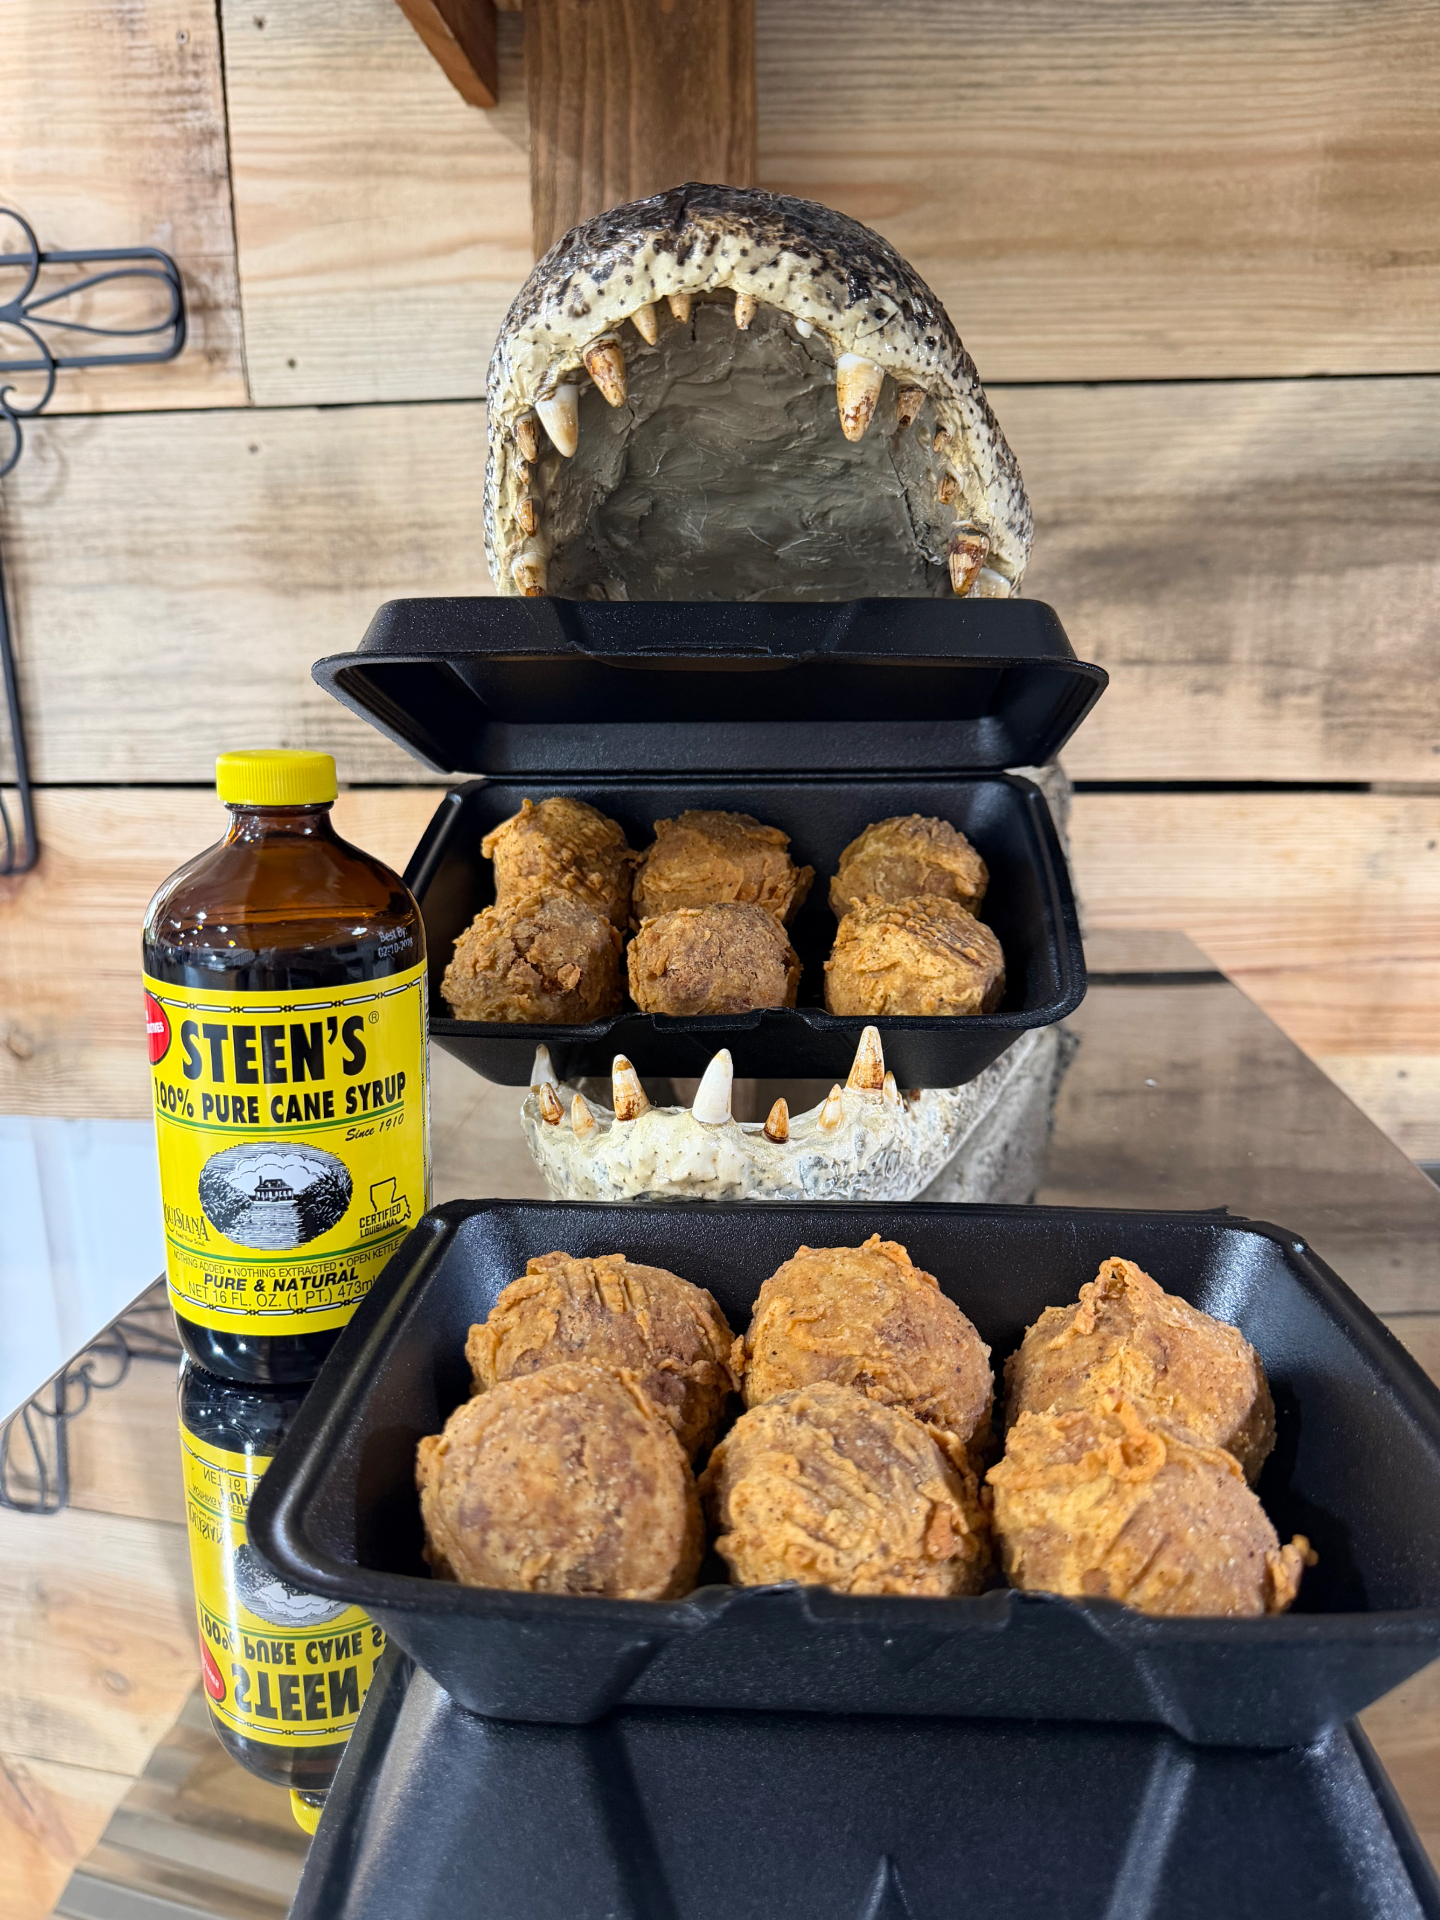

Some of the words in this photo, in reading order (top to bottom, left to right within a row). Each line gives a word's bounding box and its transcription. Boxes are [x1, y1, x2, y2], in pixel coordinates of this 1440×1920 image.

[379, 928, 396, 943] Best
[181, 1015, 367, 1085] STEEN'S
[154, 1076, 194, 1118] 100%
[202, 1092, 260, 1124] PURE
[271, 1090, 335, 1124] CANE
[345, 1071, 406, 1115] SYRUP
[345, 1127, 375, 1142] Since
[379, 1113, 404, 1132] 1910
[359, 1203, 401, 1228] CERTIFIED
[360, 1218, 397, 1239] LOUISIANA
[173, 1249, 198, 1269] NOTHING
[199, 1260, 225, 1275] ADDED
[233, 1267, 276, 1278] NOTHING
[278, 1262, 337, 1278] EXTRACTED
[346, 1252, 371, 1268] OPEN
[373, 1240, 400, 1260] KETTLE
[204, 1272, 248, 1292] PURE
[253, 1279, 266, 1292] &
[273, 1267, 359, 1293] NATURAL
[188, 1281, 209, 1299] NET
[213, 1290, 227, 1304] 16
[231, 1292, 252, 1307] FL.
[256, 1293, 282, 1307] OZ.
